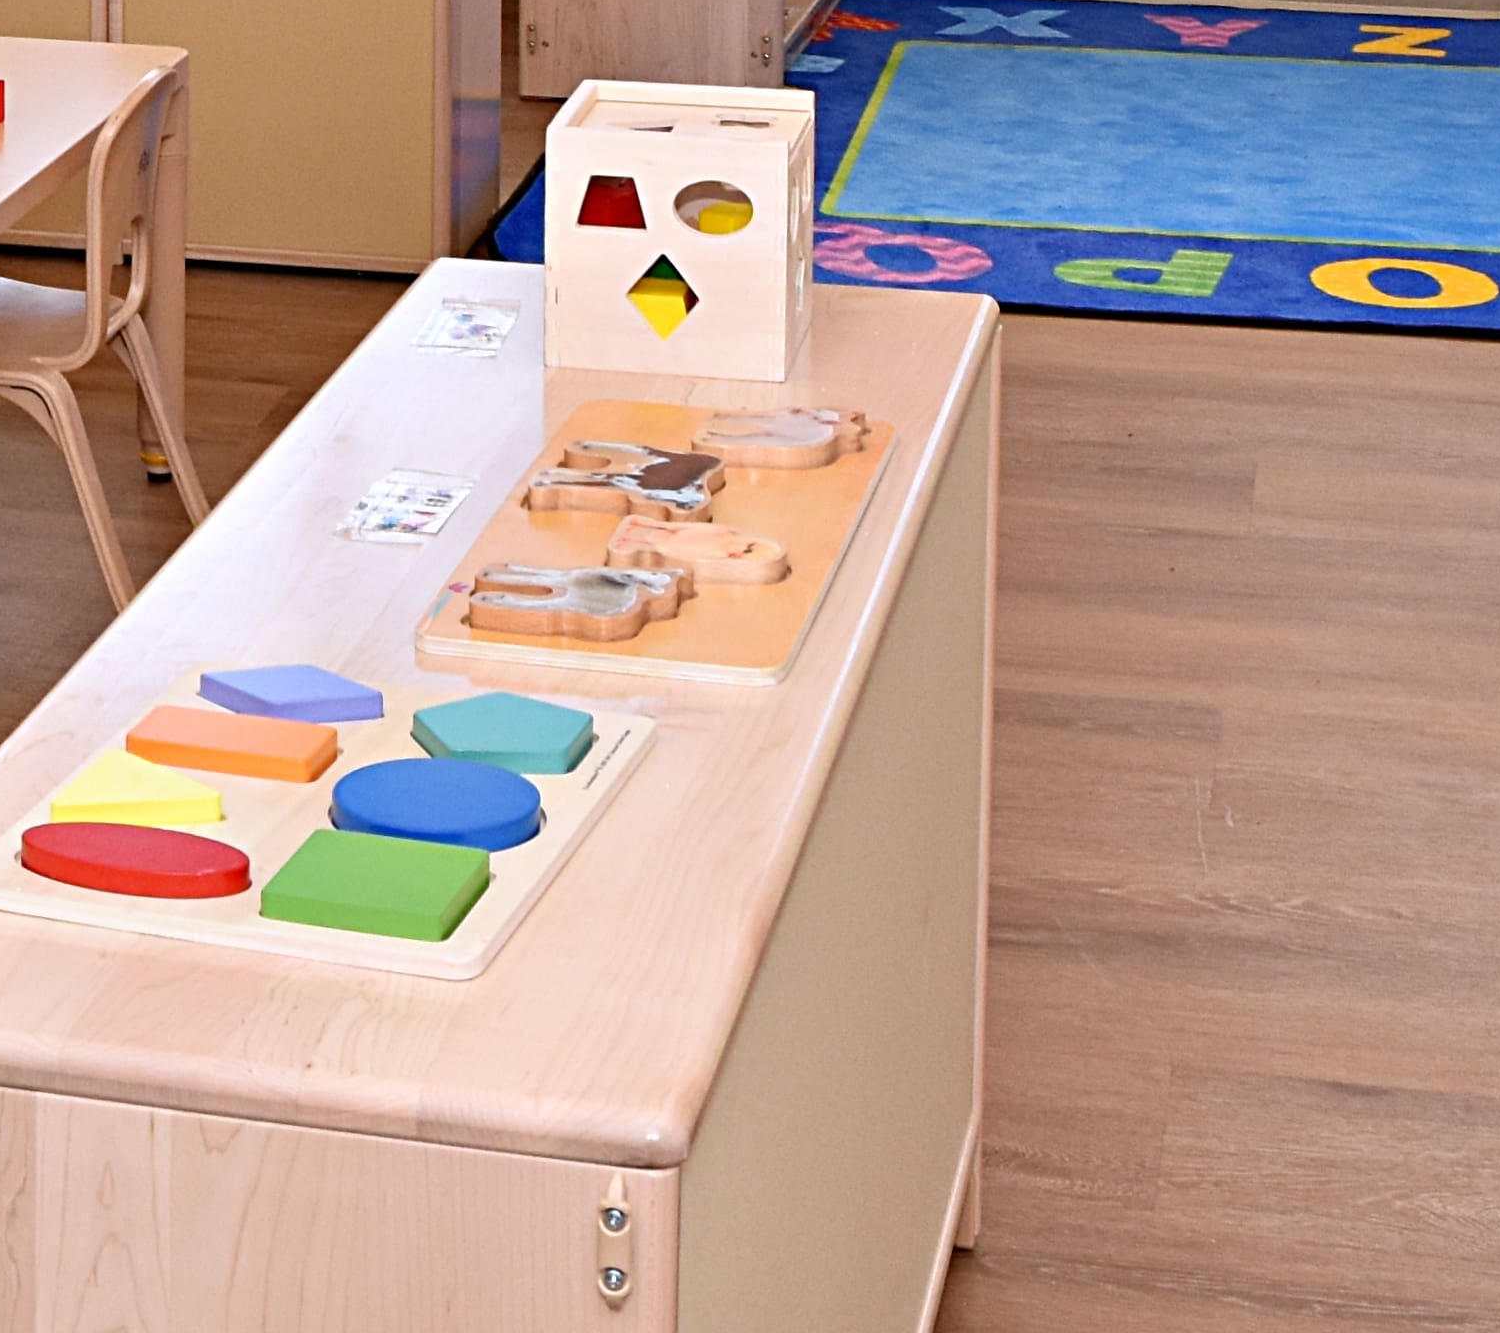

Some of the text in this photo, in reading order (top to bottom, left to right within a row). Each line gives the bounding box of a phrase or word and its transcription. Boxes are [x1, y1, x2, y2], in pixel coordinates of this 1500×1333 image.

[934, 5, 1071, 39] X
[1142, 13, 1270, 48] Y
[1352, 23, 1452, 59] Z
[1309, 256, 1500, 309] O
